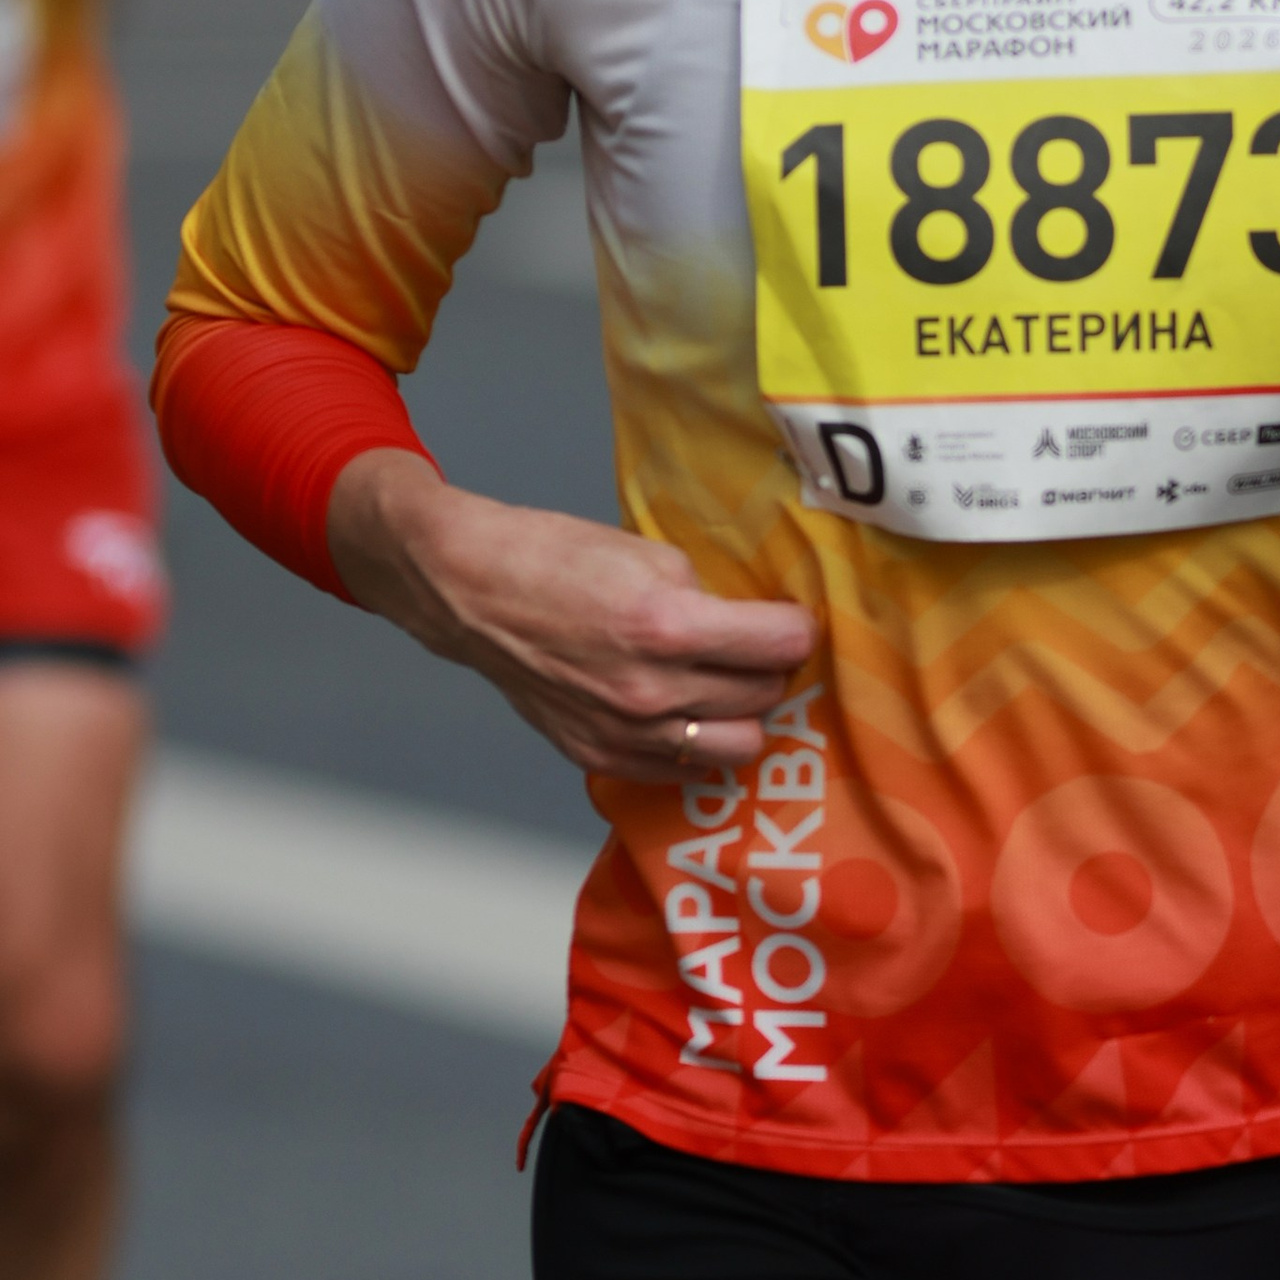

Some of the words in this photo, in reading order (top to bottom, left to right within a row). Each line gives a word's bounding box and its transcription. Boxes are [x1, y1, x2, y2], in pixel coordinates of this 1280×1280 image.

[916, 3, 1133, 36] МОСКОВСКИЙ
[917, 34, 1075, 61] МАРАФОН
[915, 311, 1214, 357] ЕКАТЕРИНА
[817, 422, 885, 507] D
[746, 683, 828, 1082] МОСКВА
[665, 764, 748, 1072] МАРАФ
